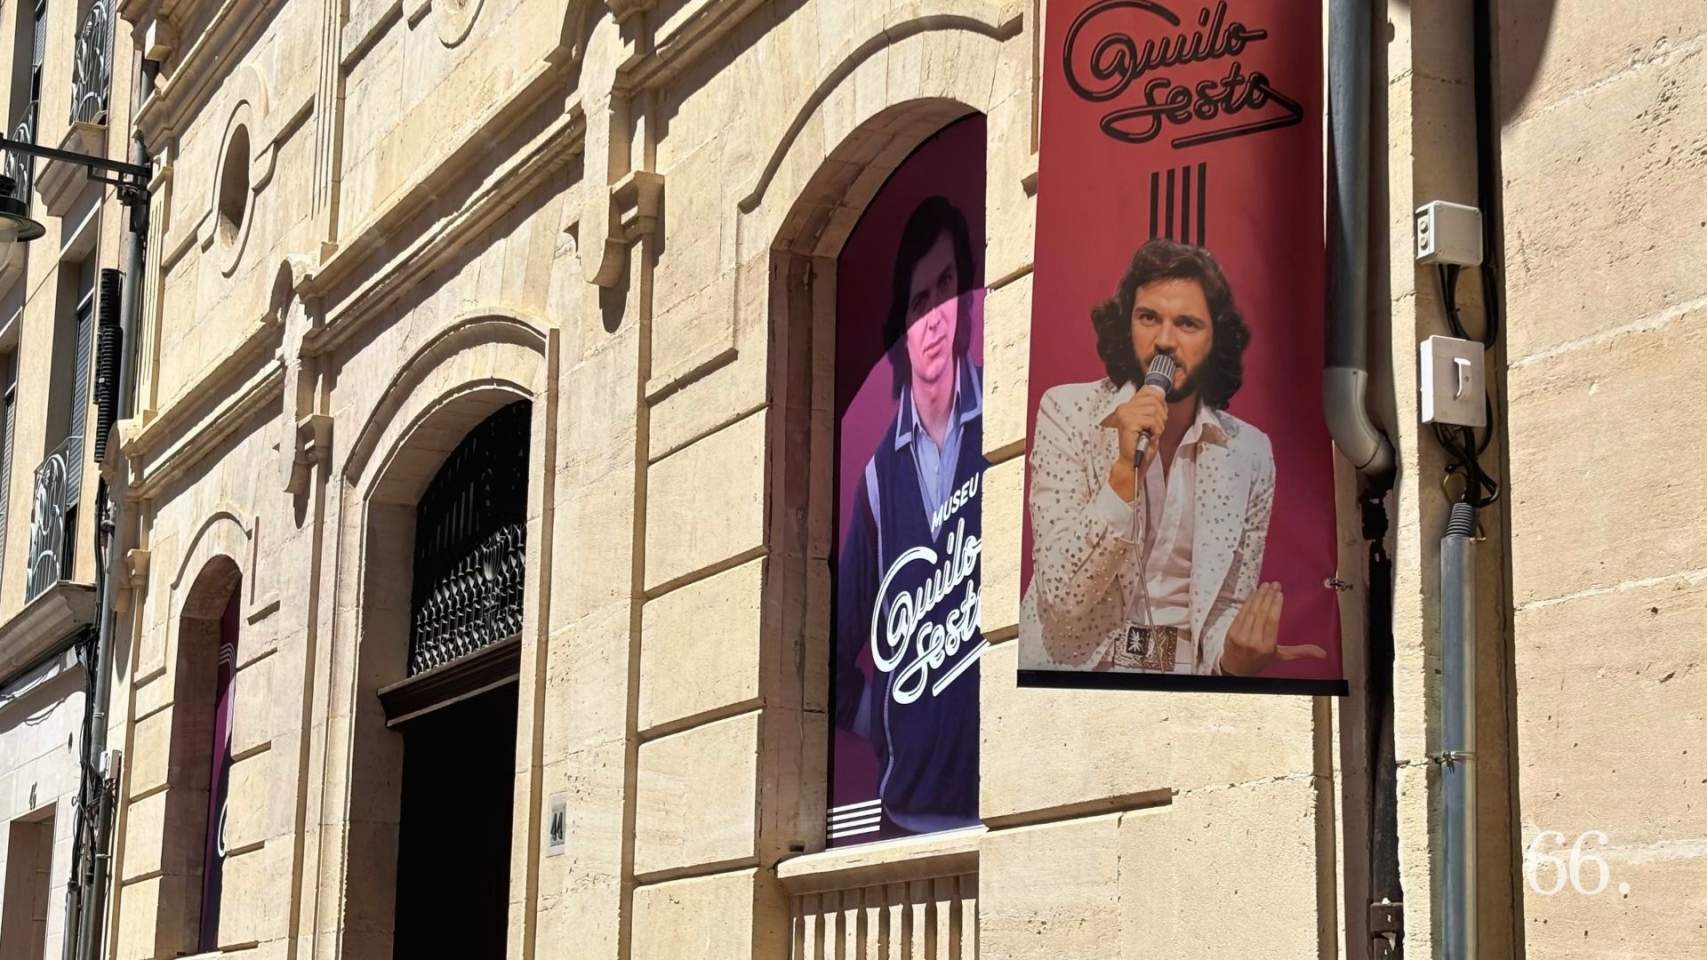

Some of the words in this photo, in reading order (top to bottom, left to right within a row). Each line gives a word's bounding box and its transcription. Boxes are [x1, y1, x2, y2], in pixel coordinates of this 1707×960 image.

[1064, 0, 1268, 101] Camilo
[1100, 63, 1304, 148] Sesto
[871, 518, 982, 673] Camilo
